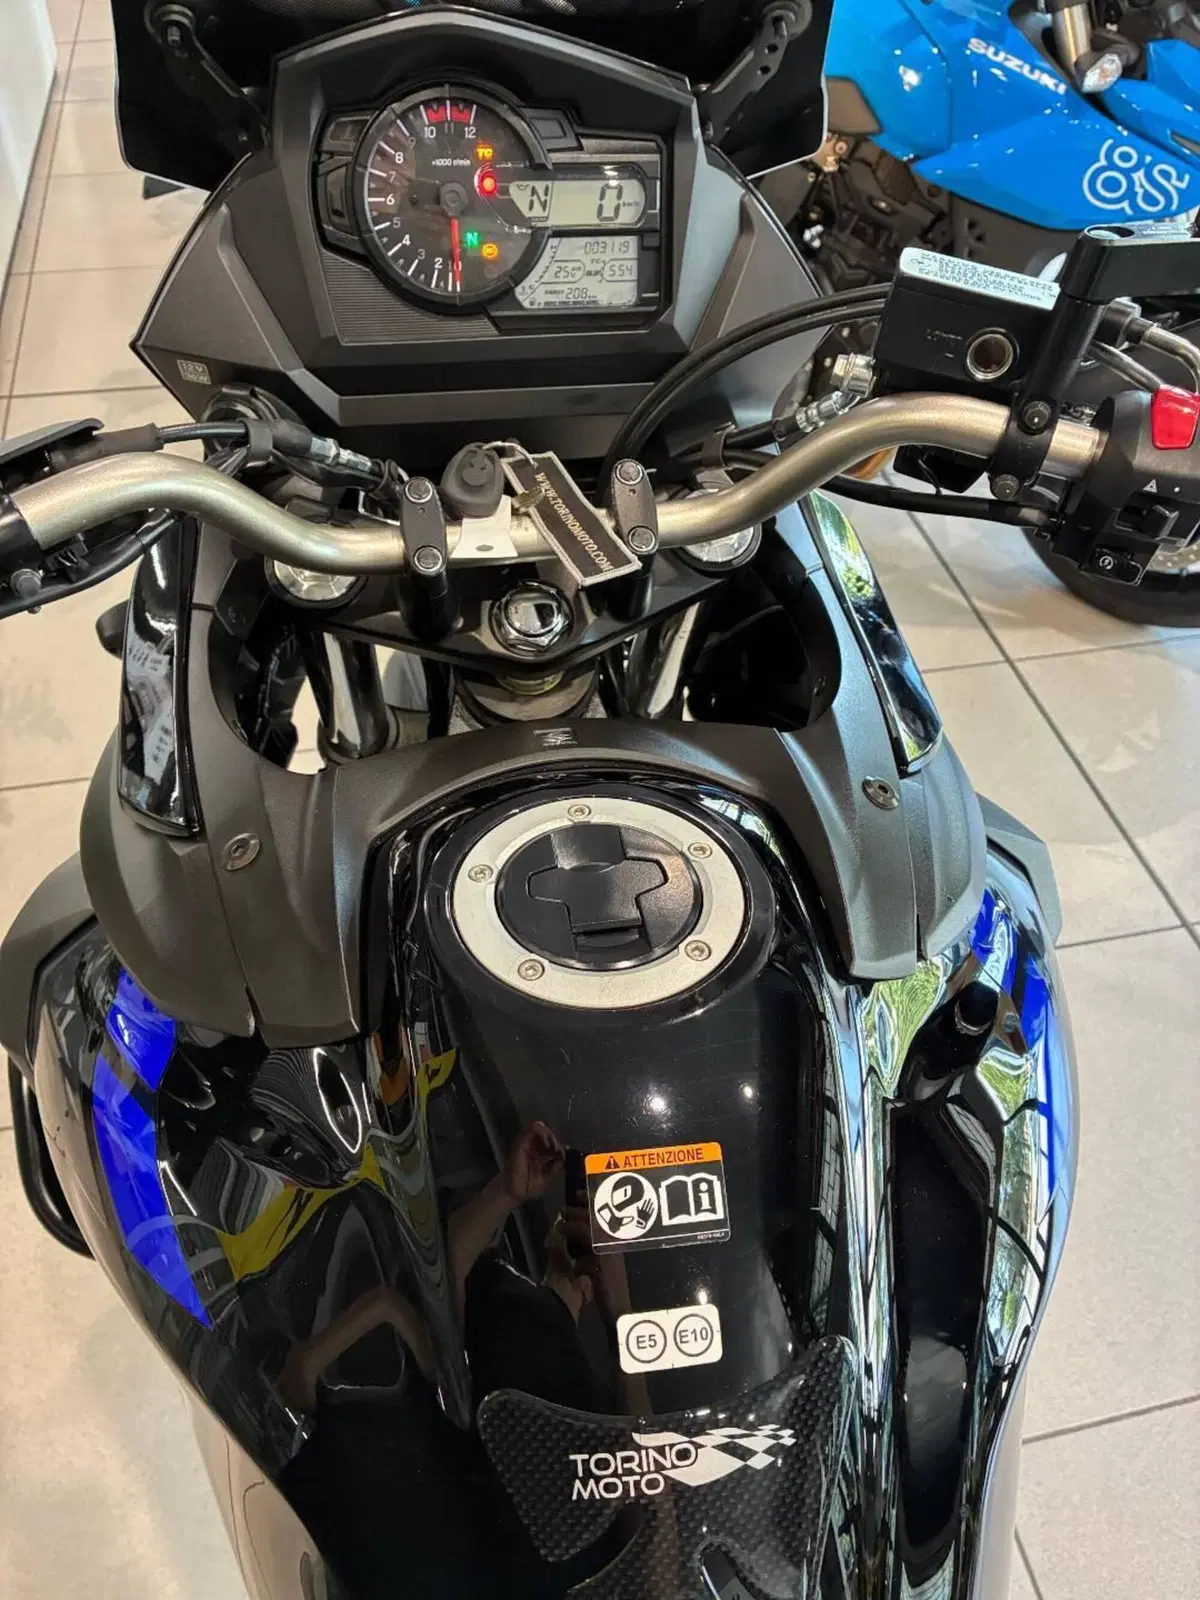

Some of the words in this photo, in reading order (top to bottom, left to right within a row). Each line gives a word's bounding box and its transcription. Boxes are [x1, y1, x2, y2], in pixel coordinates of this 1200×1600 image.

[967, 37, 1067, 96] SUZUKI
[424, 126, 437, 139] 10
[464, 126, 477, 139] 12
[394, 151, 405, 164] 8
[387, 170, 397, 182] 7
[386, 193, 396, 206] 6
[528, 184, 550, 213] N
[597, 183, 623, 222] 0
[391, 216, 402, 229] 5
[401, 233, 412, 247] 4
[465, 231, 480, 248] N
[417, 248, 427, 260] 3
[583, 240, 630, 255] 003119
[433, 257, 443, 269] 2
[554, 265, 570, 279] 25
[623, 1148, 704, 1168] ATTENZIONE
[636, 1334, 657, 1350] E5
[679, 1326, 709, 1344] E10
[568, 1442, 697, 1477] TORINO
[571, 1472, 665, 1501] MOTO
